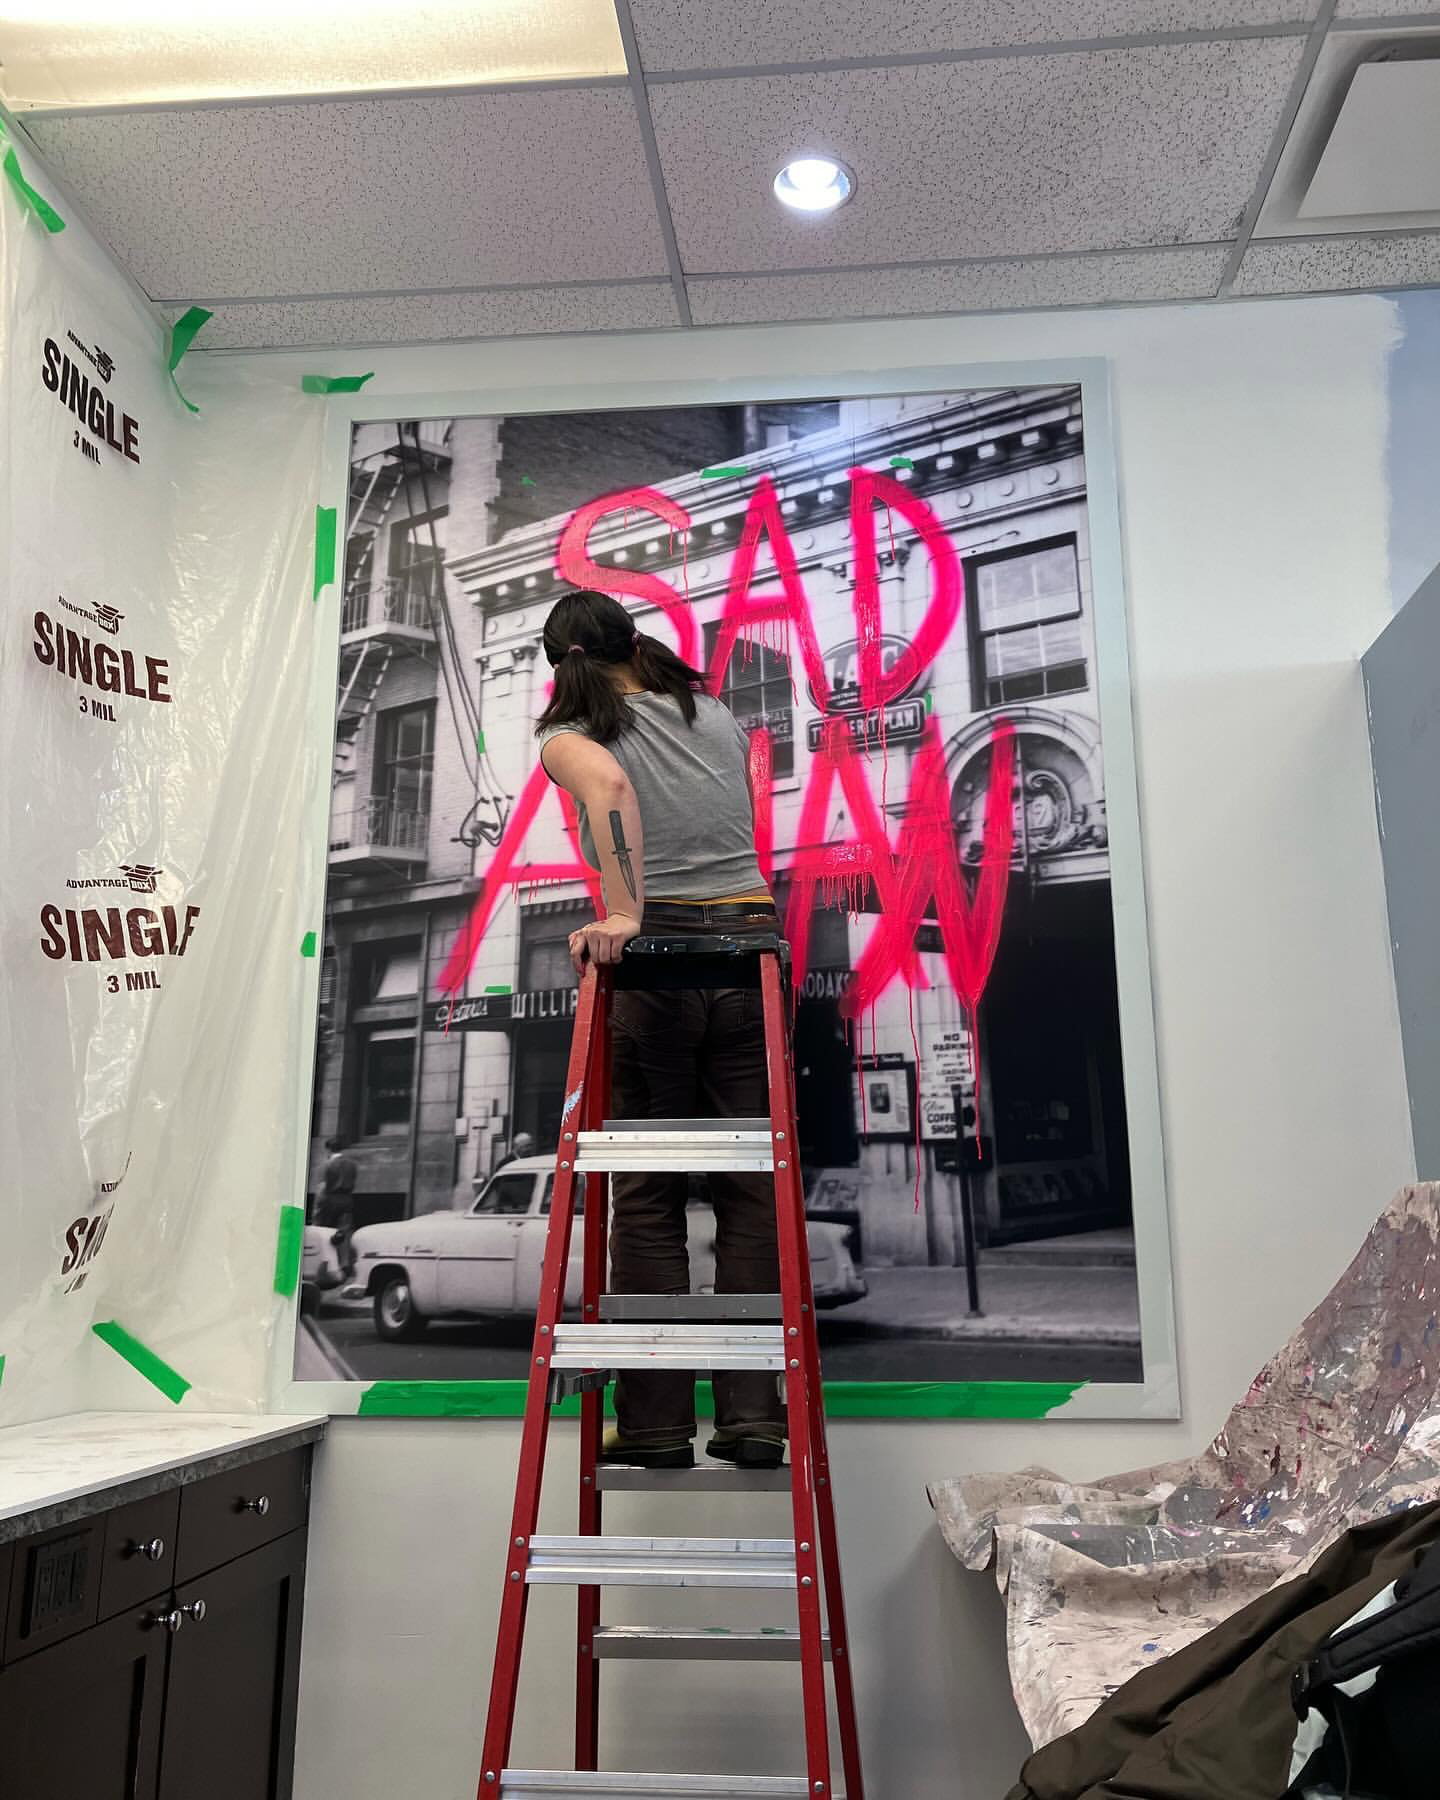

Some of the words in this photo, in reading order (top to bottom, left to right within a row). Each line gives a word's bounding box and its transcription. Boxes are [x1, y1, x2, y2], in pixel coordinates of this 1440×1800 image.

[42, 338, 140, 464] SINGLE
[73, 430, 80, 448] 3
[82, 436, 101, 465] MIL
[33, 611, 172, 703] SINGLE
[79, 695, 88, 713] 3
[91, 701, 117, 722] MIL
[66, 878, 129, 889] ADVANTAGE
[106, 975, 120, 993] 3
[125, 970, 161, 991] MIL
[943, 1033, 960, 1042] NO
